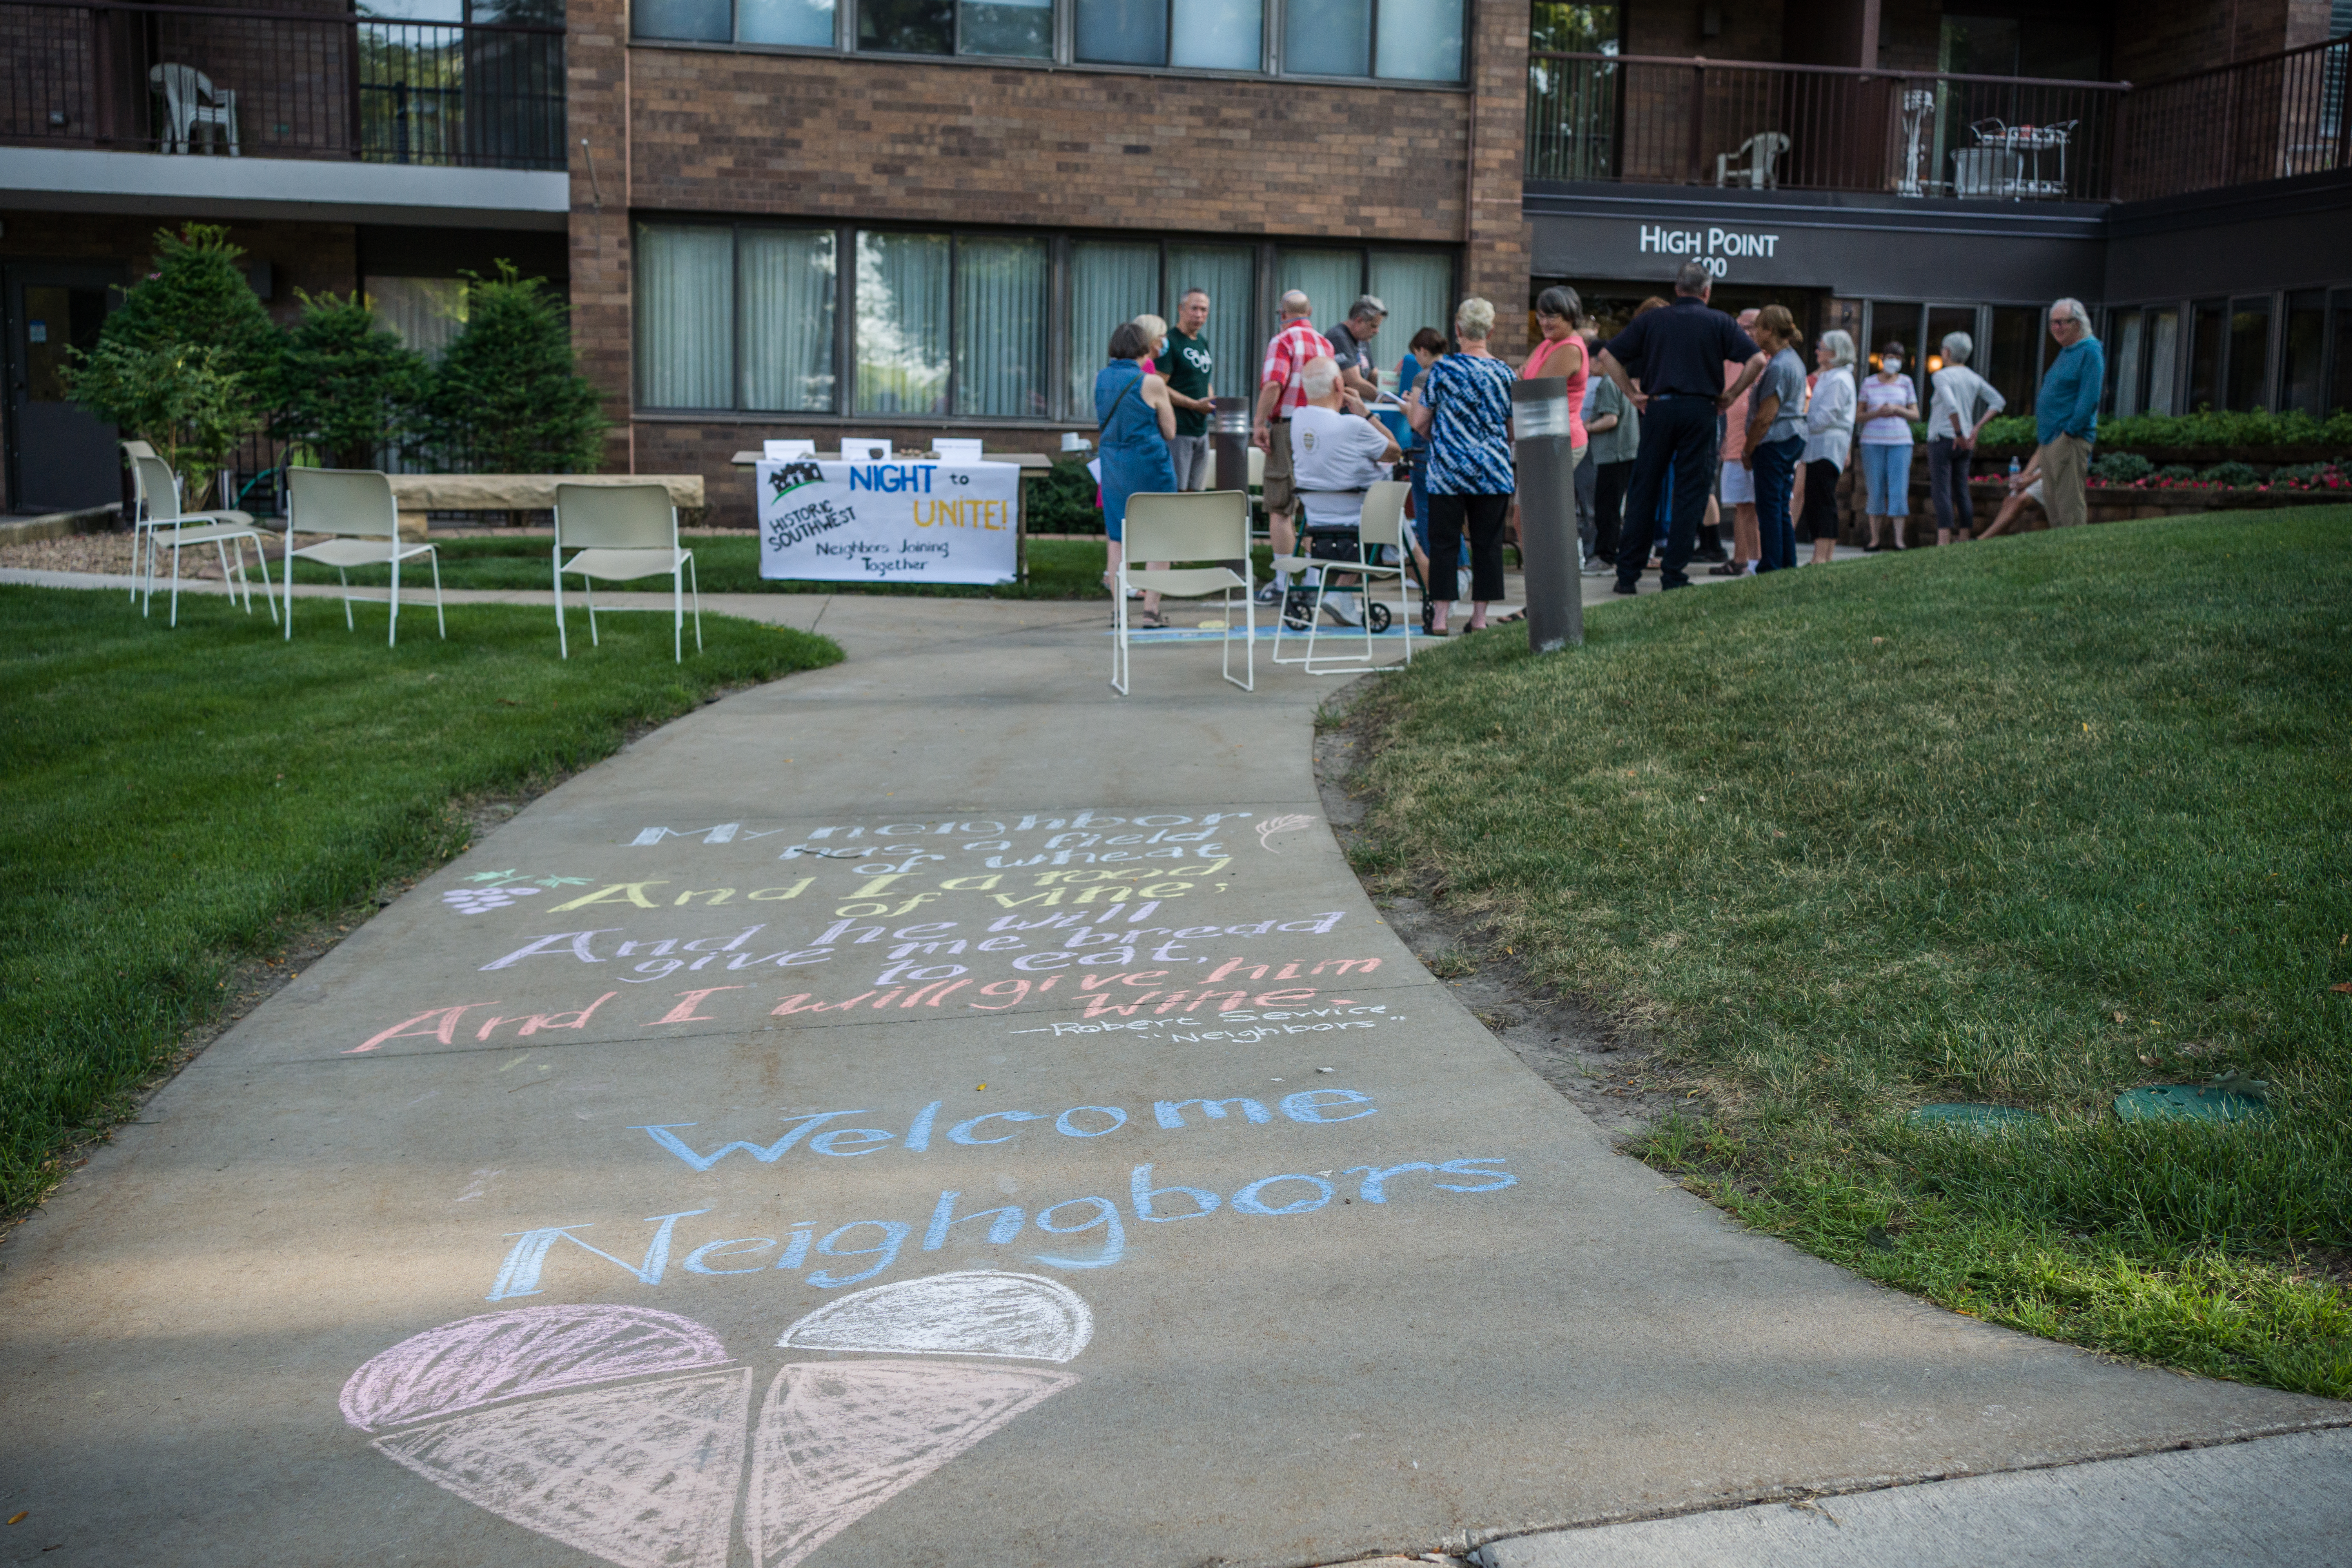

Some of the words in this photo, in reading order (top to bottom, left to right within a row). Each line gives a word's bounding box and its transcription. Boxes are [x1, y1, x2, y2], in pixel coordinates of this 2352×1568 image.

[1640, 225, 1702, 254] HIGH
[1708, 227, 1779, 258] POINT
[1691, 256, 1728, 278] 00
[849, 464, 938, 493] NIGHT
[950, 473, 969, 485] to
[768, 506, 856, 552] SOUTHWEST
[769, 499, 834, 535] HISTORIC
[816, 539, 889, 559] Neighbors
[900, 539, 949, 558] Joining
[861, 557, 929, 576] Together
[619, 822, 784, 847] My
[808, 811, 1252, 840] neighbor
[778, 843, 925, 860] has
[962, 840, 1011, 851] a
[1044, 826, 1220, 849] field
[852, 854, 946, 875] of
[985, 842, 1229, 868] wheat
[546, 877, 818, 913] And
[838, 872, 926, 900] I
[939, 874, 1004, 890] a
[1033, 857, 1234, 886] rood
[835, 892, 942, 917] of
[477, 924, 768, 971] And
[807, 918, 958, 947] he
[987, 901, 1162, 932] will
[615, 947, 836, 983] give
[886, 935, 1028, 959] me
[1063, 911, 1348, 948] bread
[873, 959, 969, 985] to
[1012, 939, 1209, 971] eat,
[339, 991, 619, 1054] And
[639, 985, 747, 1026] I
[769, 978, 975, 1016] will
[968, 970, 1170, 1009] give
[1198, 956, 1383, 985] him
[1218, 1005, 1388, 1022] Service
[625, 1088, 1377, 1172] Welcome
[486, 1157, 1520, 1301] Neighgbors
